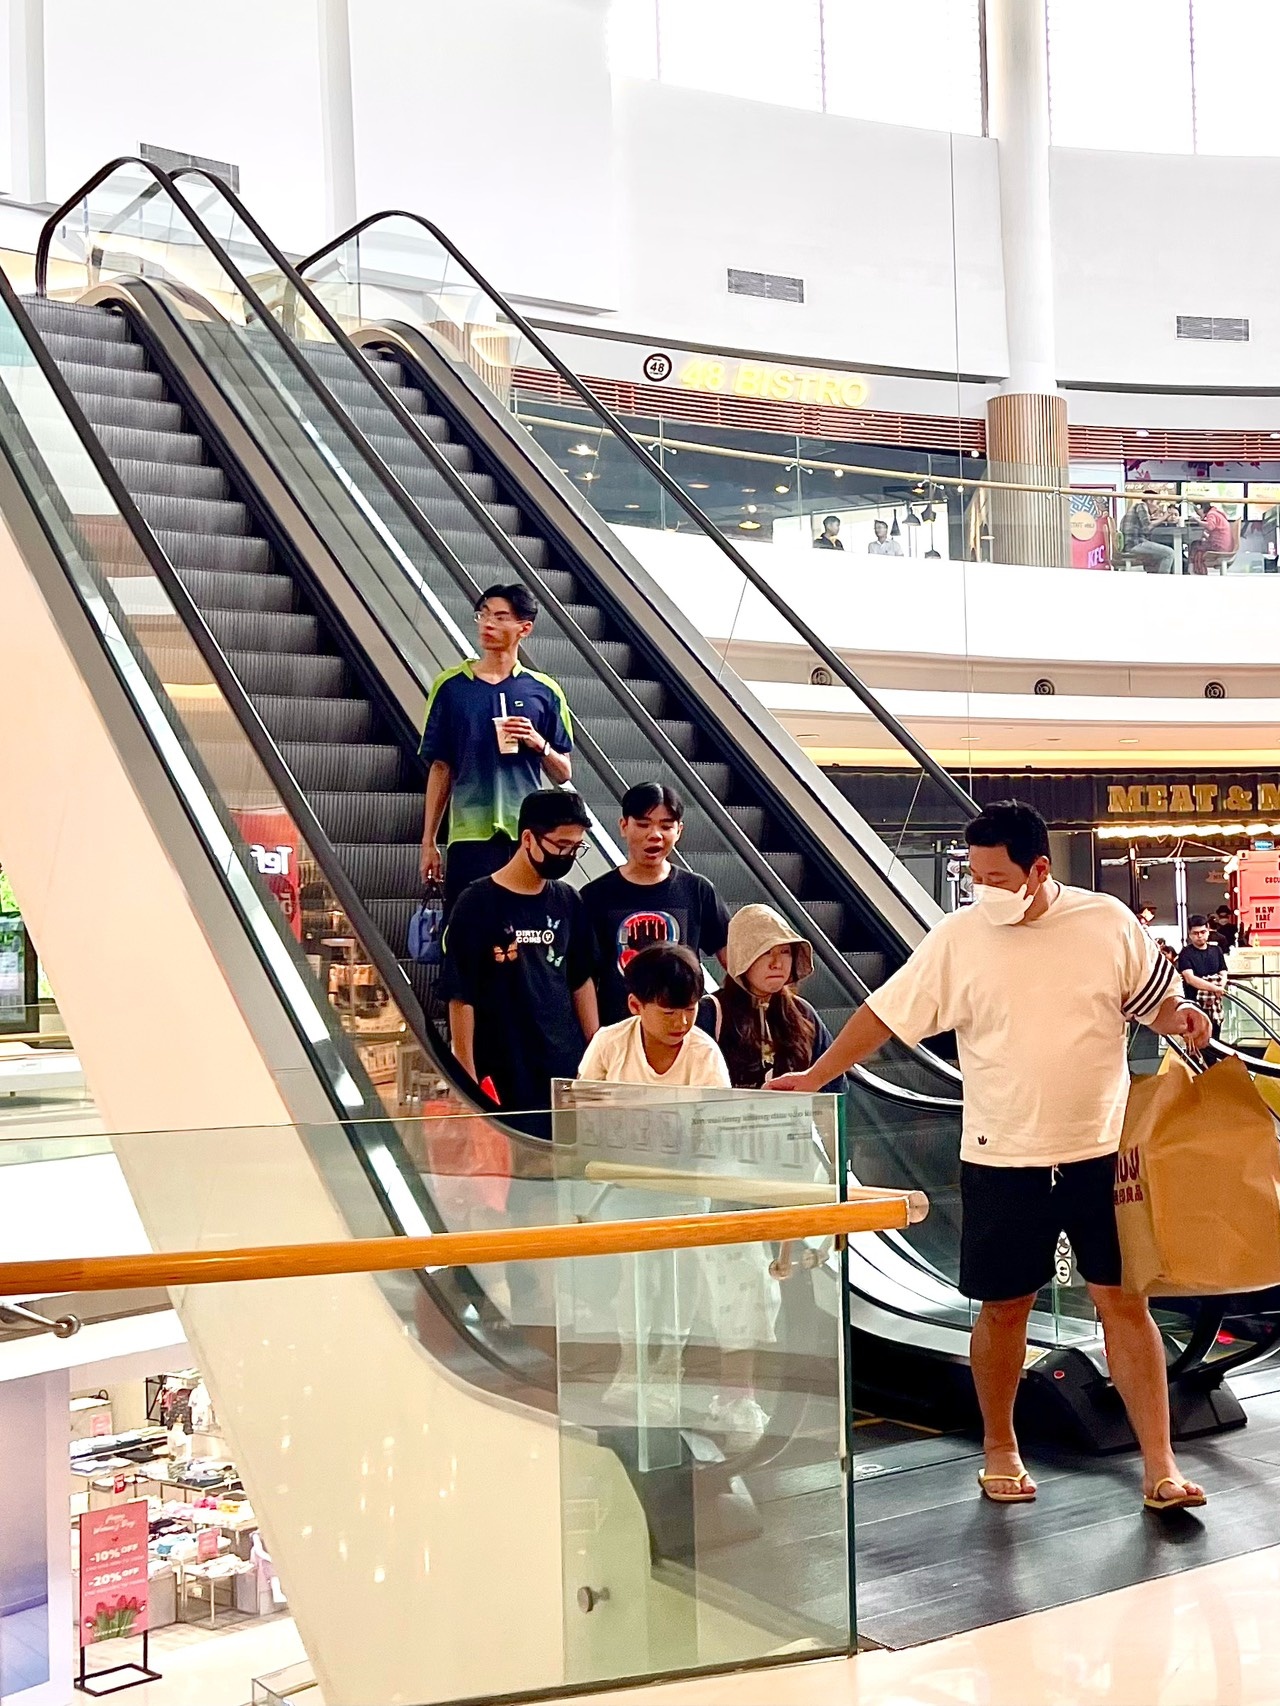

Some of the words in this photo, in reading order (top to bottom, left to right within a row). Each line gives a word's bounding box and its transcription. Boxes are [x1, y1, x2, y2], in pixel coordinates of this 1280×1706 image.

[650, 361, 665, 373] 48
[680, 360, 727, 392] 48
[734, 364, 870, 408] BISTRO
[1107, 785, 1218, 813] MEAT
[1224, 786, 1253, 811] &
[516, 936, 542, 944] COINS
[89, 1547, 121, 1563] -10%
[121, 1543, 139, 1554] OFF
[88, 1571, 122, 1588] -20%
[122, 1567, 140, 1578] OFF
